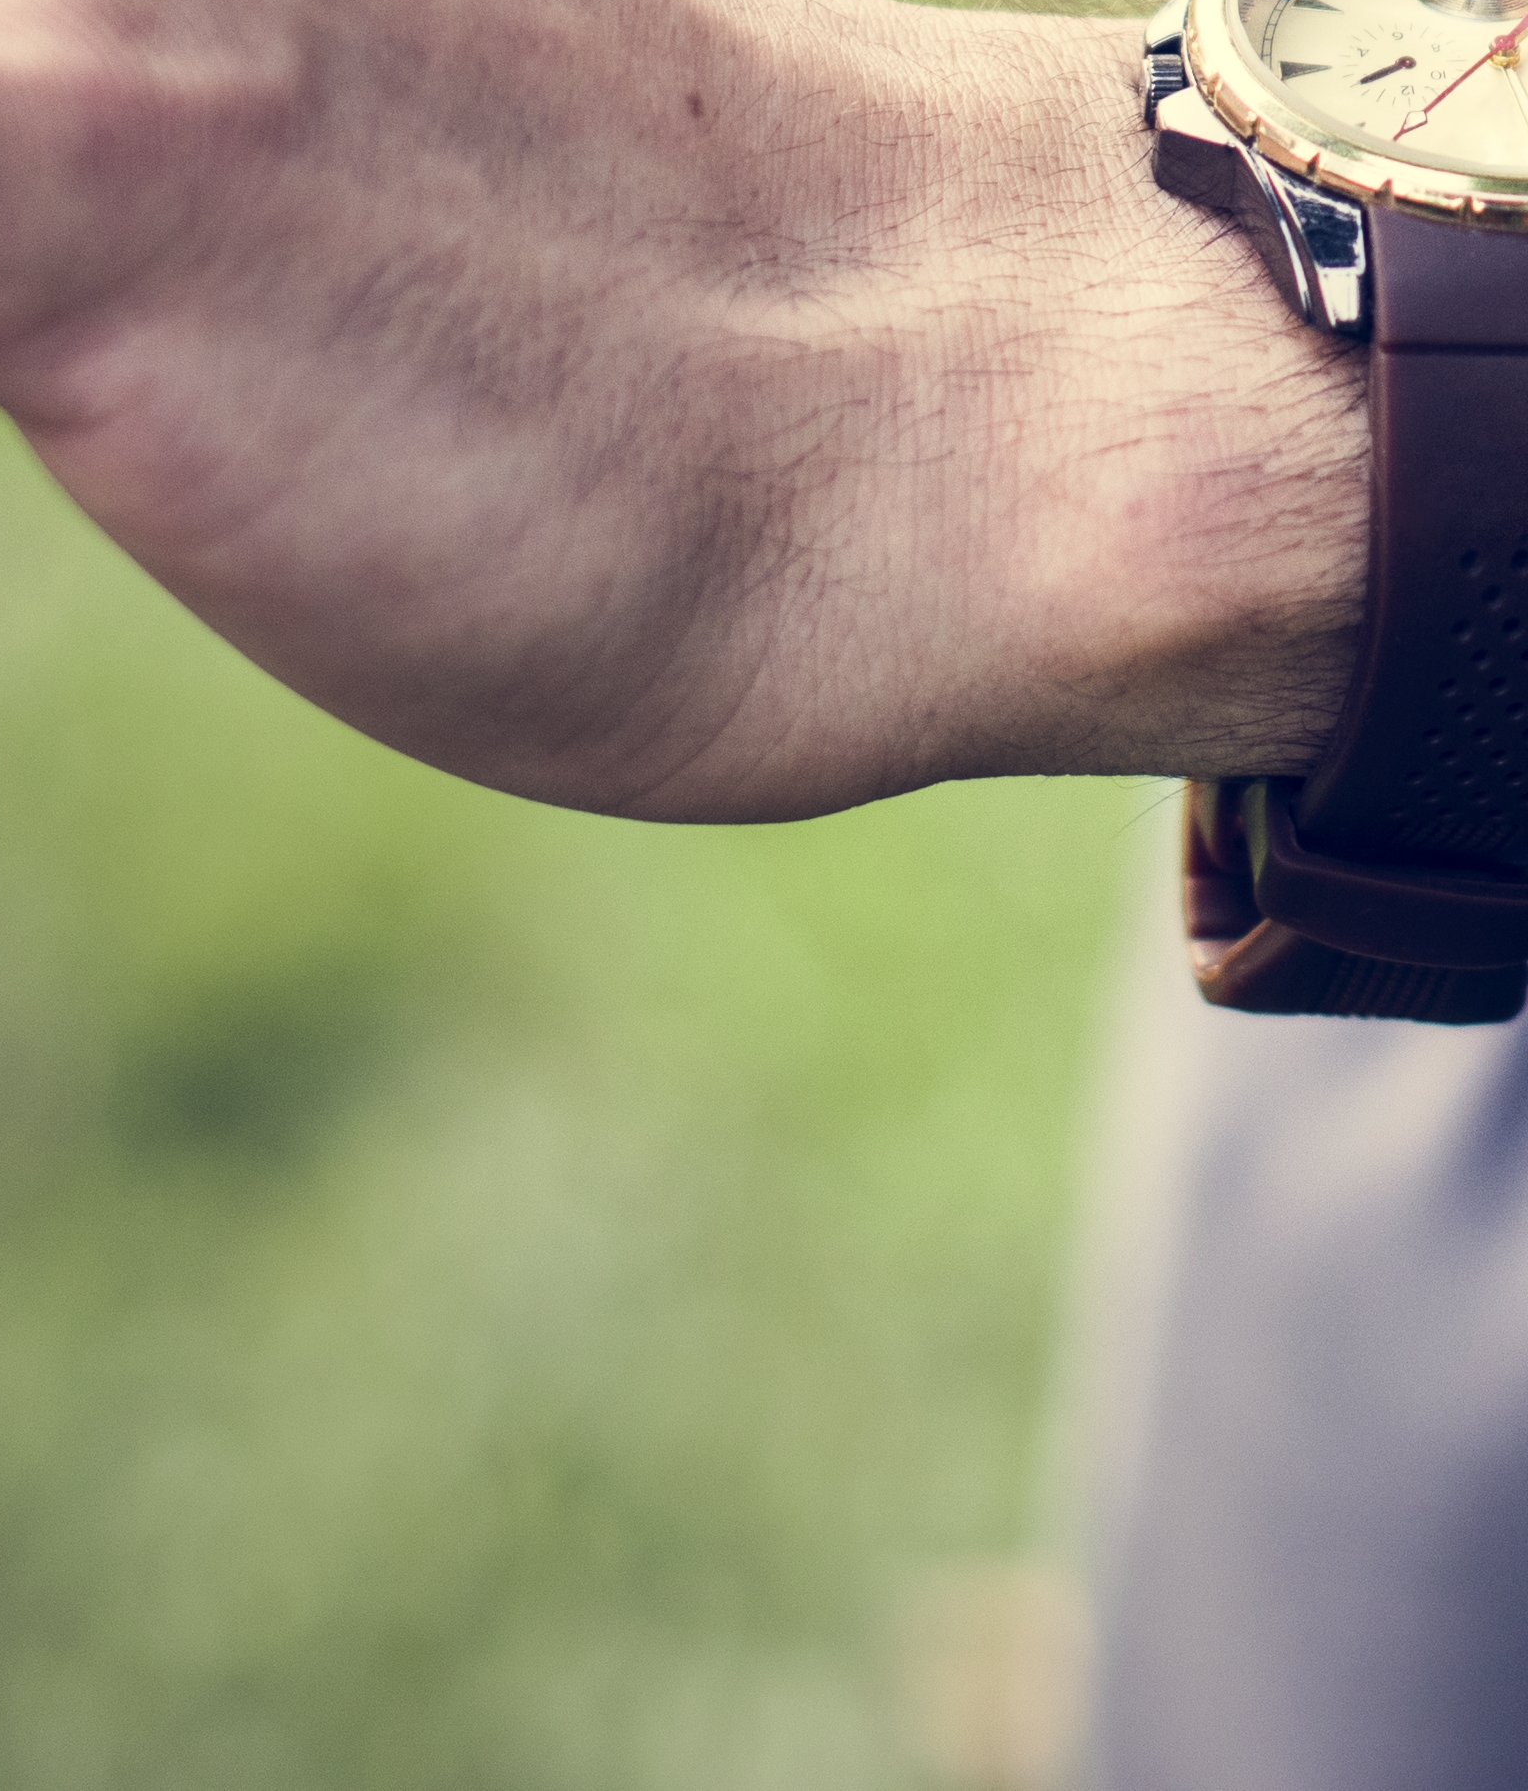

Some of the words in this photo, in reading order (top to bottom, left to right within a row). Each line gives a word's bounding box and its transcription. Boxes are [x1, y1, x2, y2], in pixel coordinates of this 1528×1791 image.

[1392, 31, 1404, 40] 6
[1431, 43, 1441, 52] 8
[1356, 48, 1370, 57] 4
[1430, 70, 1447, 80] 10
[1400, 85, 1415, 95] 12
